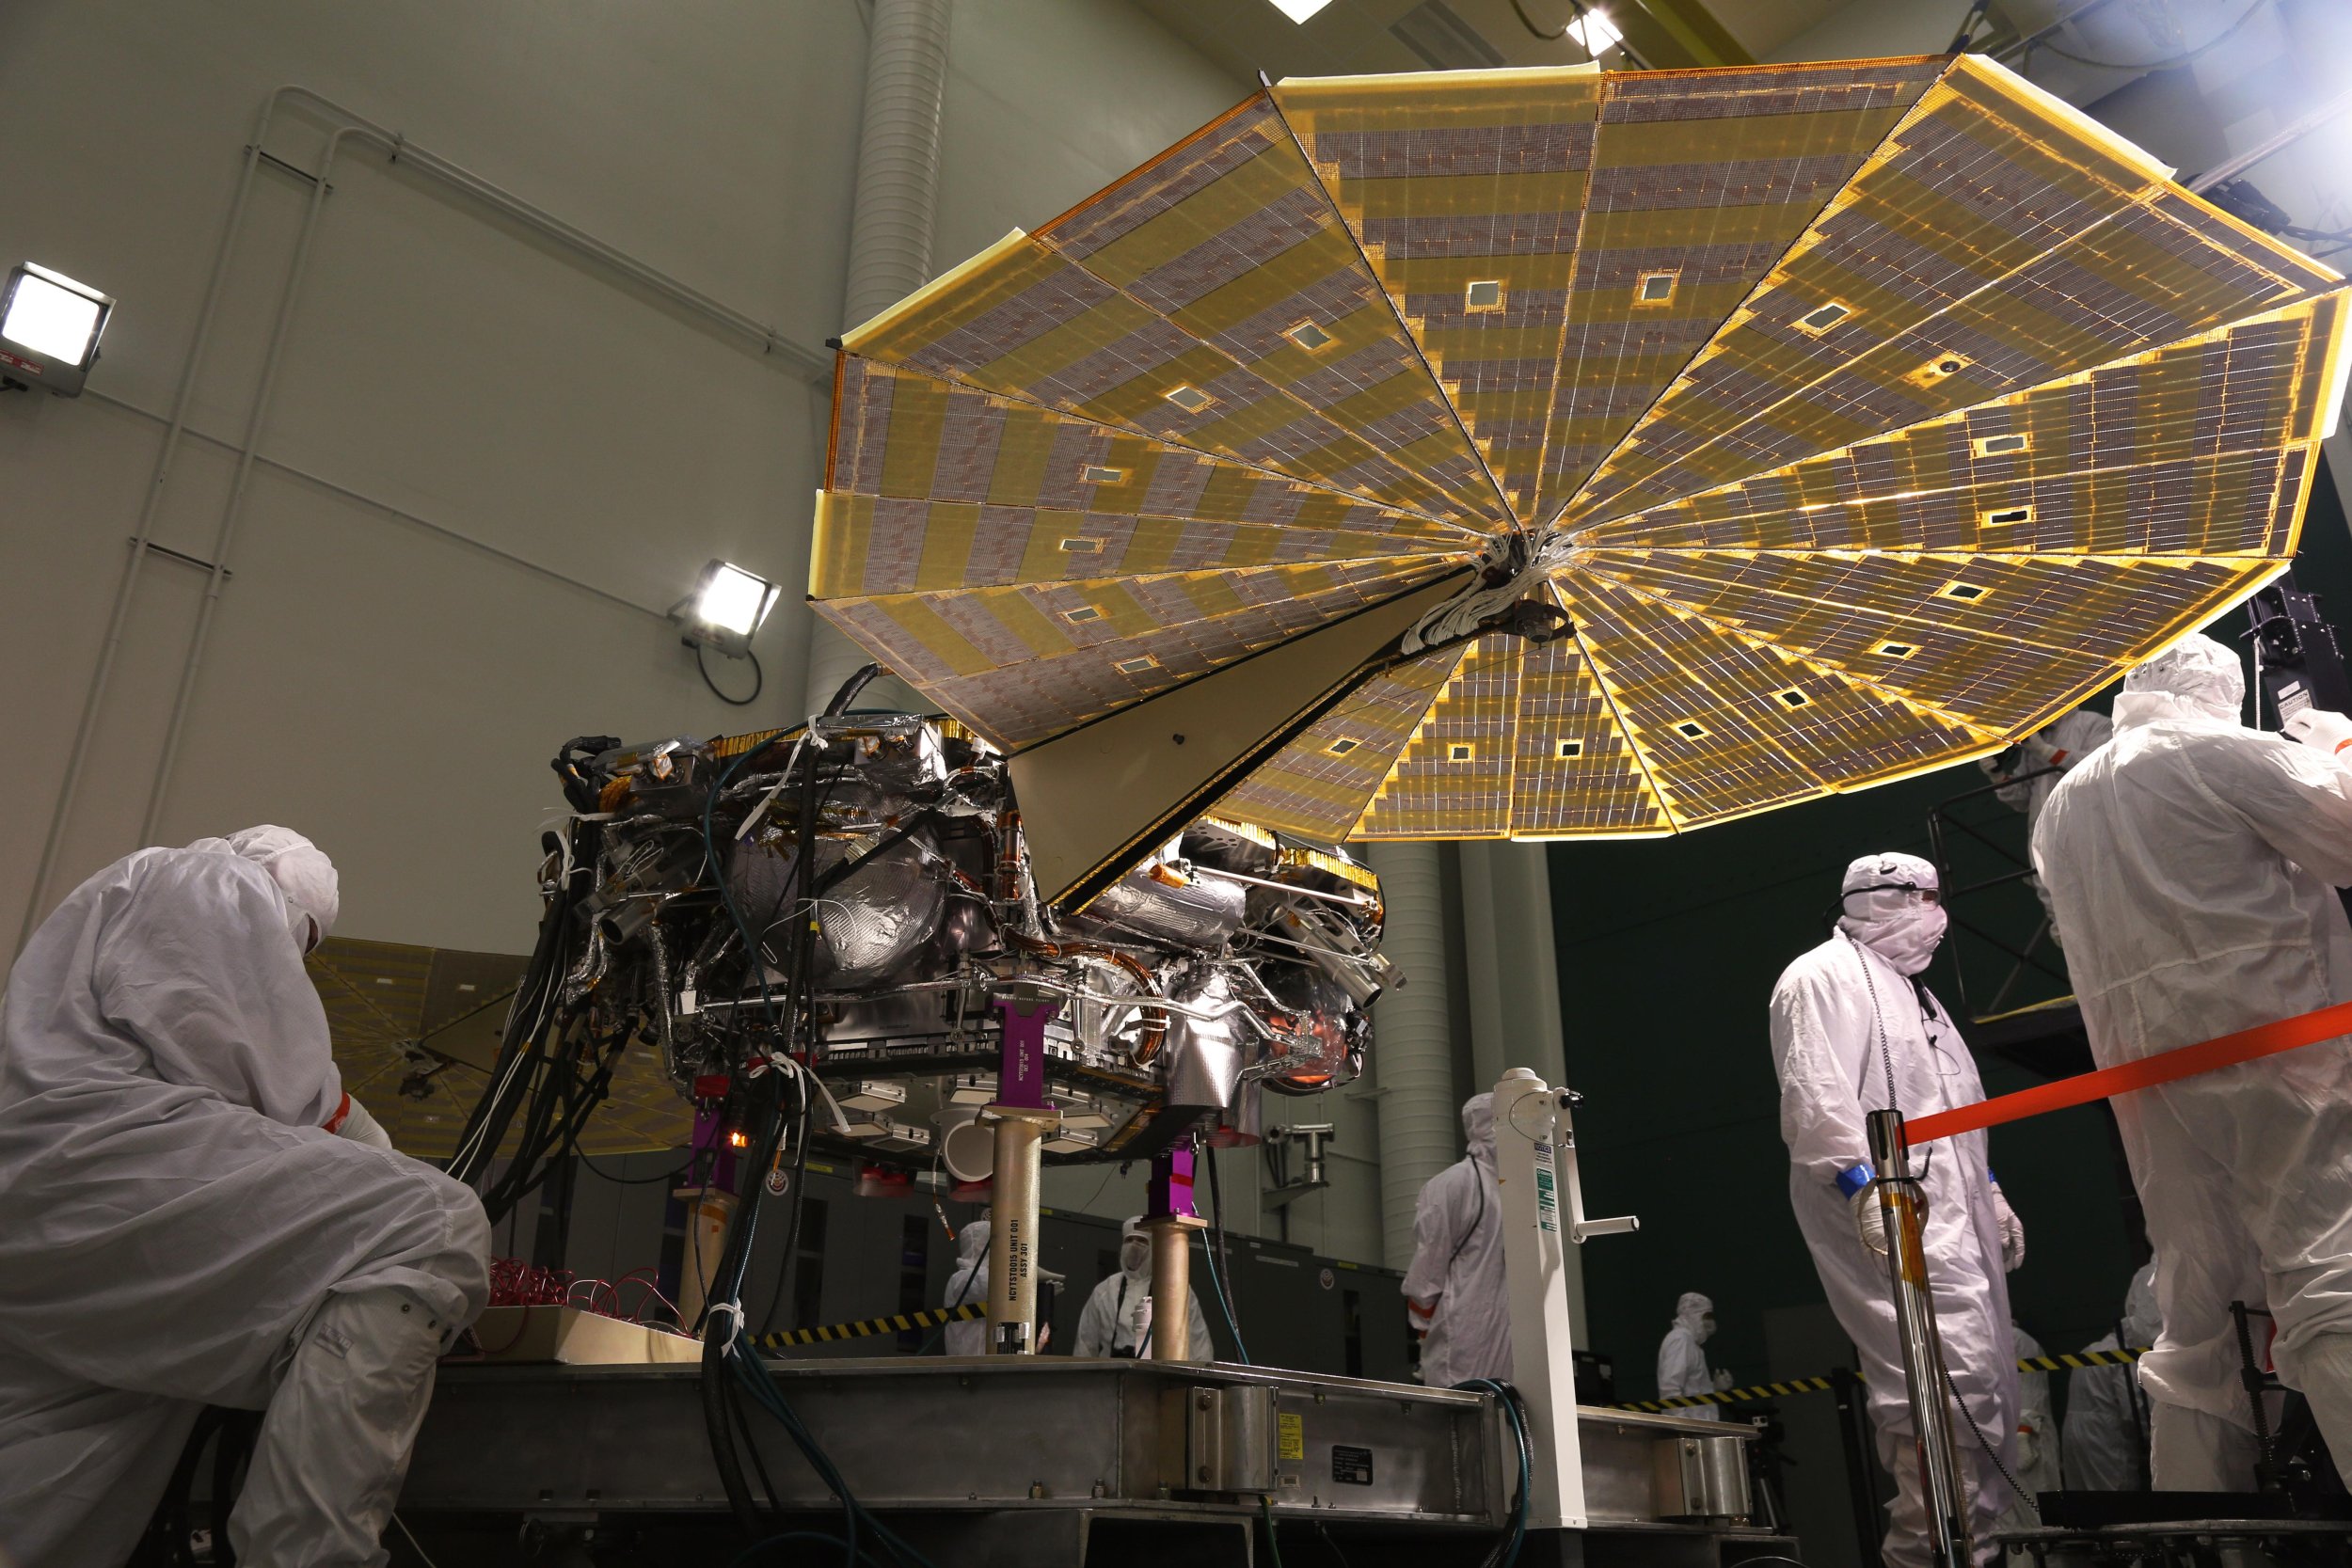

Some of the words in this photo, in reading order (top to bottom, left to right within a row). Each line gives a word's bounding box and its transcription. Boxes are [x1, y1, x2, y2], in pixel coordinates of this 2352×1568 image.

[2280, 691, 2308, 710] CAUTION
[1534, 1143, 1551, 1153] NOTICE
[1010, 1219, 1019, 1233] 001
[1009, 1234, 1018, 1252] UNIT
[1009, 1254, 1017, 1301] NCYTST0015
